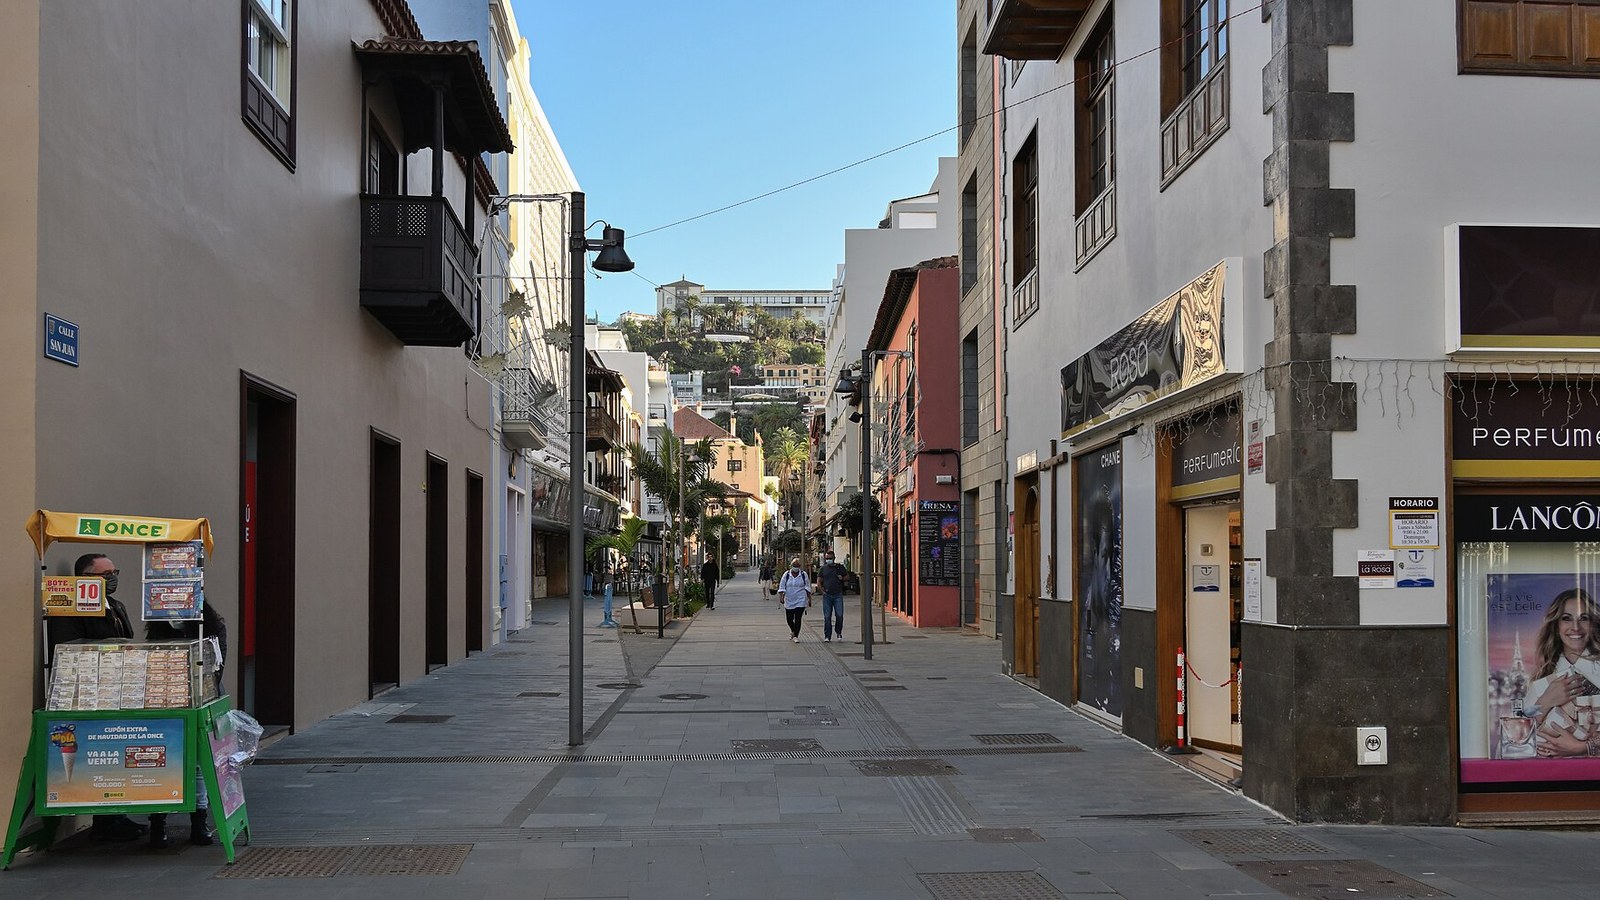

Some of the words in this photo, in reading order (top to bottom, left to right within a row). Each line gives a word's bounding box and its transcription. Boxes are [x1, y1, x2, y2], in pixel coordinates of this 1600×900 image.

[58, 325, 75, 339] CALLE
[50, 339, 62, 352] SAN
[62, 343, 75, 357] JUAN
[1490, 500, 1600, 530] LANCÔ
[104, 522, 162, 537] ONCE
[79, 584, 98, 599] 10
